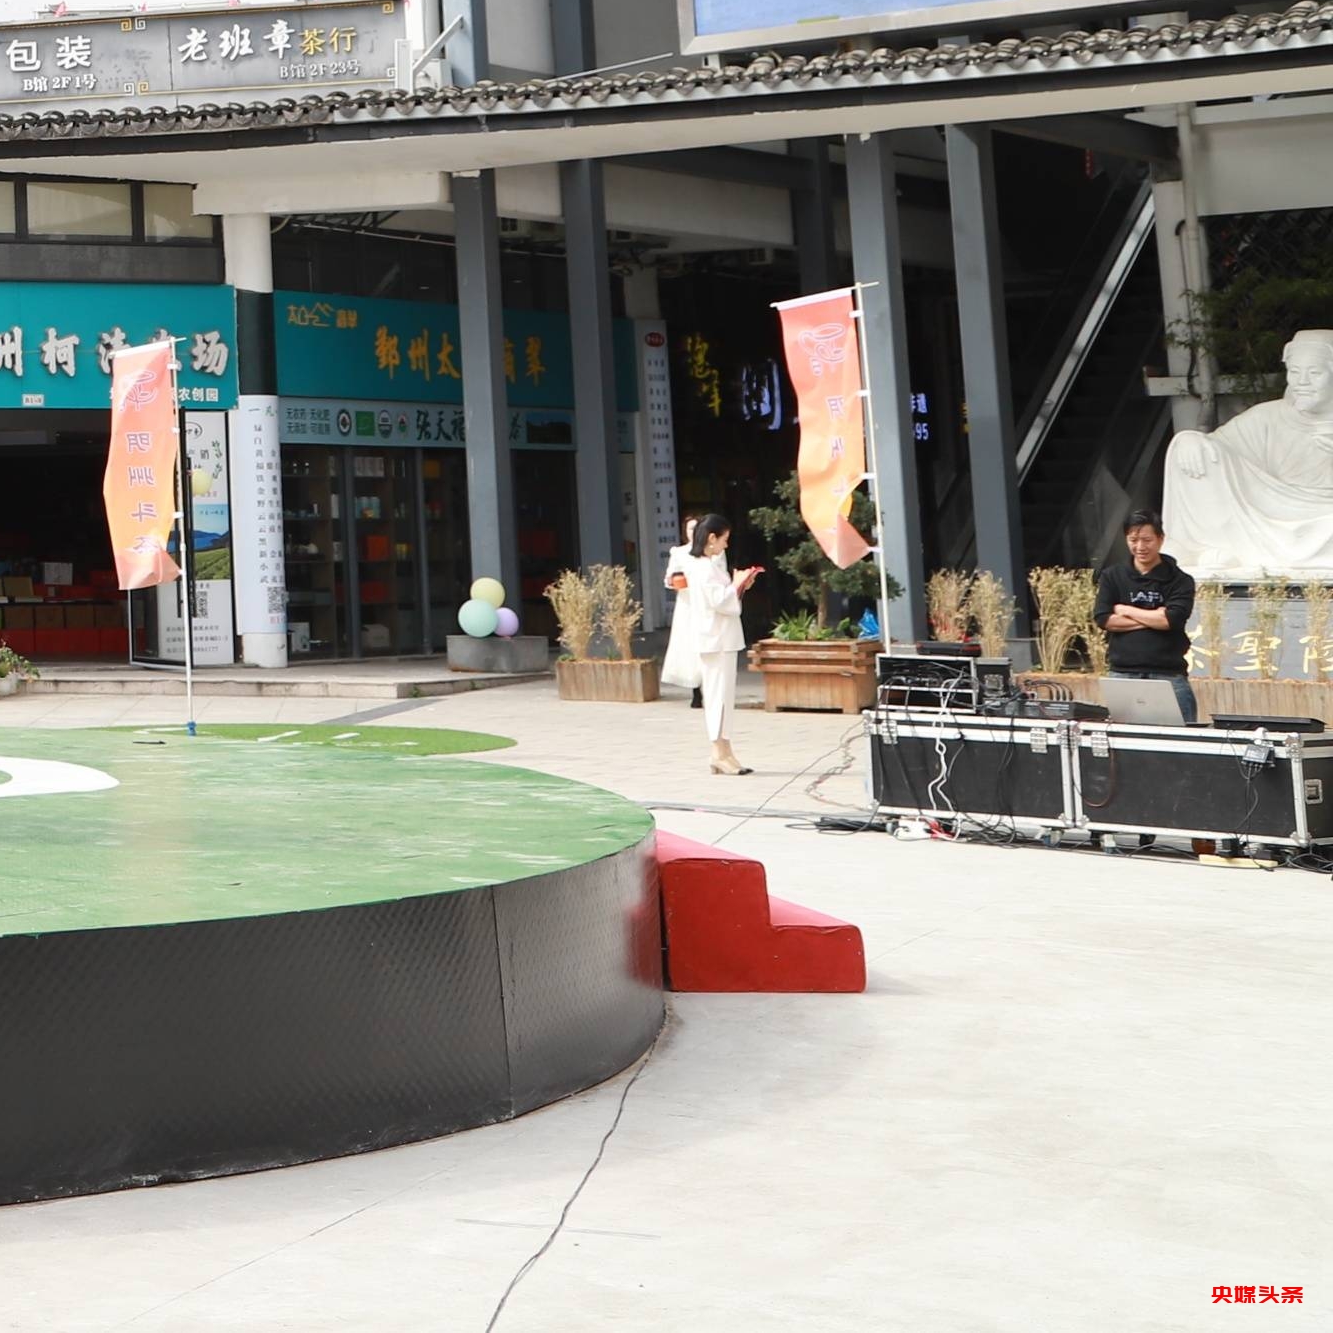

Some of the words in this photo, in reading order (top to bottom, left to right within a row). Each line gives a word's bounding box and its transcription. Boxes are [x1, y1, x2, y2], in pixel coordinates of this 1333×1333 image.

[178, 20, 357, 63] 老班章茶行
